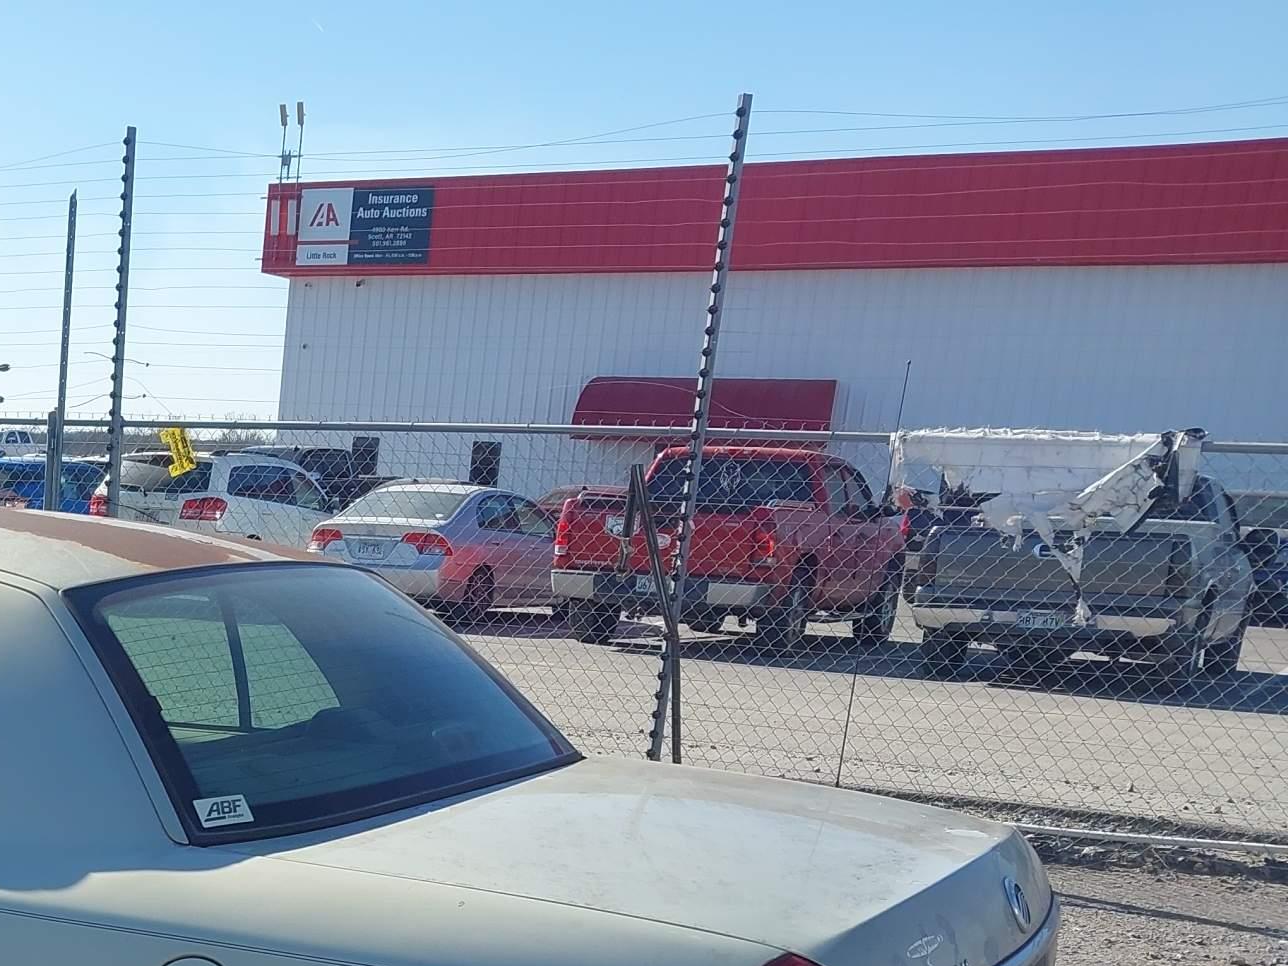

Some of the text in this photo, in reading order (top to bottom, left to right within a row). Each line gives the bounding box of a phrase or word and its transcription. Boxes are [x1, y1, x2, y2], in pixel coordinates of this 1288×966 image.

[368, 192, 419, 205] Insurance
[356, 205, 428, 219] Auto Auctions
[306, 251, 337, 260] Little Rock
[206, 798, 242, 818] ABF
